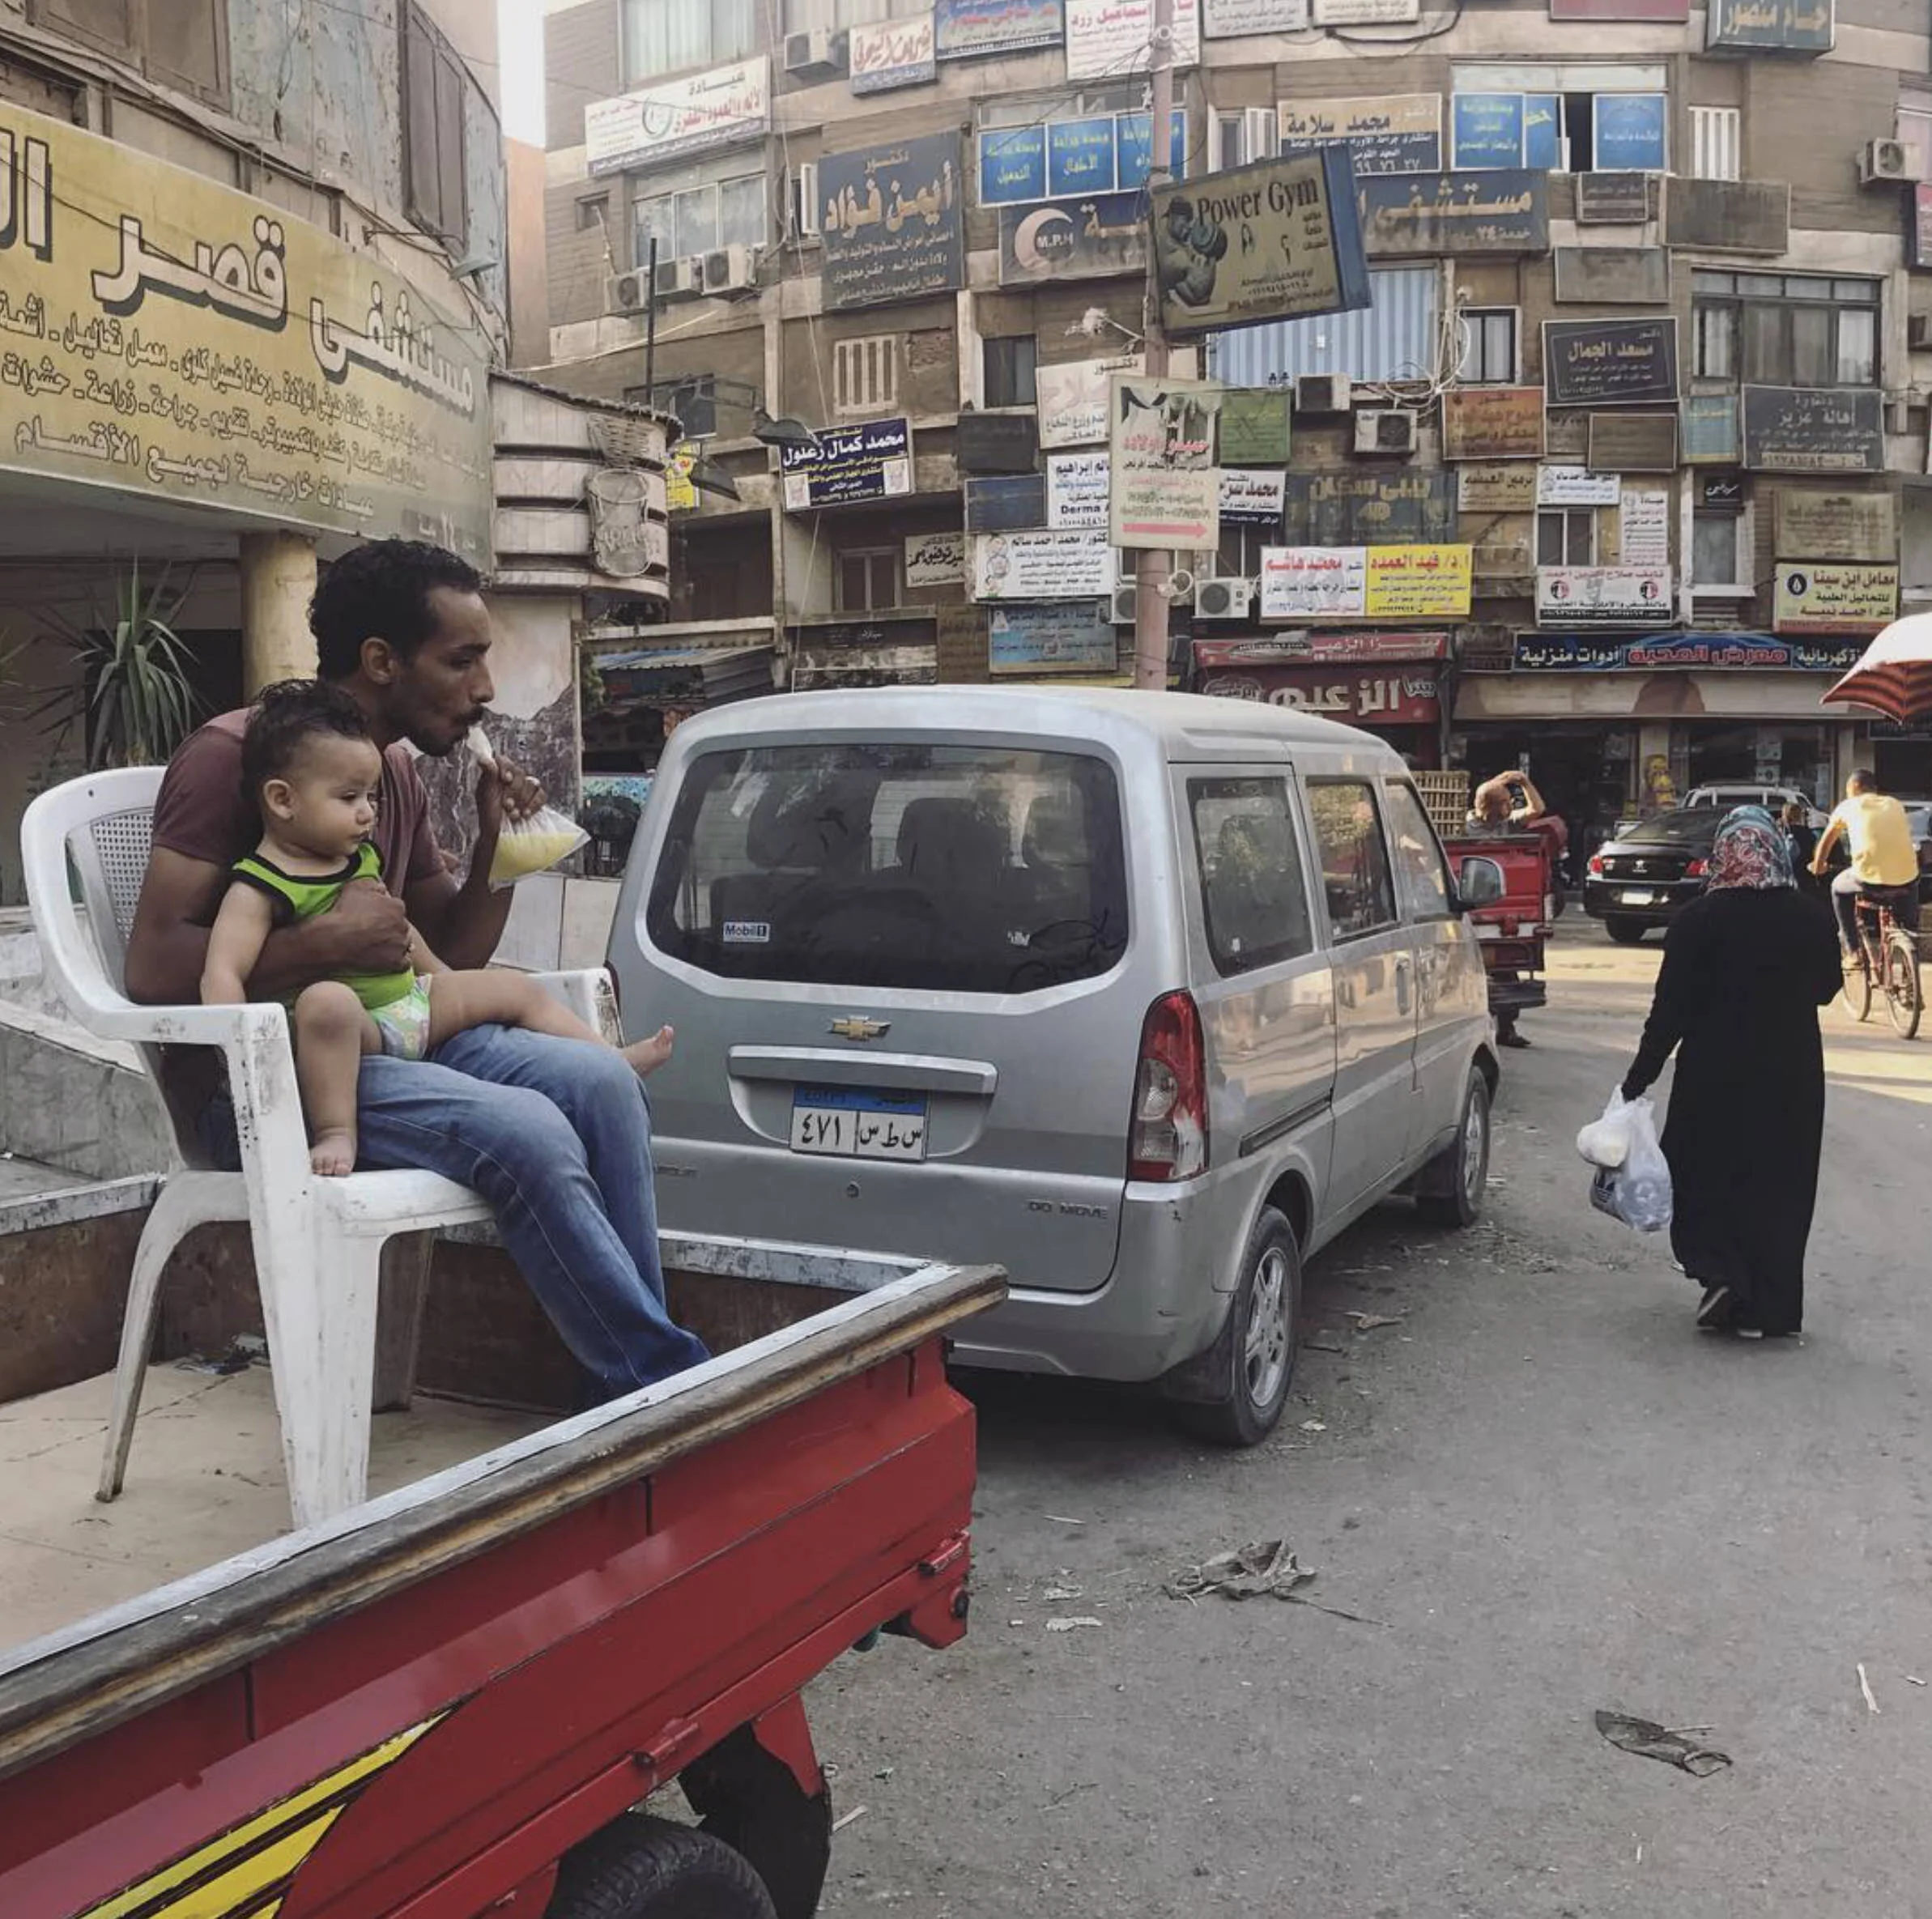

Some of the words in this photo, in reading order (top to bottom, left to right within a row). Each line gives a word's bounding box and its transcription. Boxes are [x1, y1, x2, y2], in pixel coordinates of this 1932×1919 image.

[1285, 112, 1335, 136] سلامة
[1347, 114, 1391, 131] محمد
[885, 160, 954, 232] أيمن
[1197, 188, 1262, 227] Power
[1268, 177, 1320, 219] Gym
[824, 177, 883, 240] فؤاد
[91, 215, 288, 329] قصر
[1567, 340, 1612, 363] الجمال
[85, 368, 138, 416] زراعة
[827, 436, 864, 460] كمال
[866, 433, 905, 449] محمد
[146, 445, 230, 491] لجميع
[235, 453, 314, 505] خارجية
[1061, 504, 1101, 515] Derma
[1813, 569, 1841, 589] سينا
[1841, 570, 1862, 590] ابن
[1862, 569, 1896, 589] معامل
[1849, 592, 1891, 604] للتحاليل
[1520, 646, 1575, 668] منزلية
[1710, 645, 1787, 667] معرض
